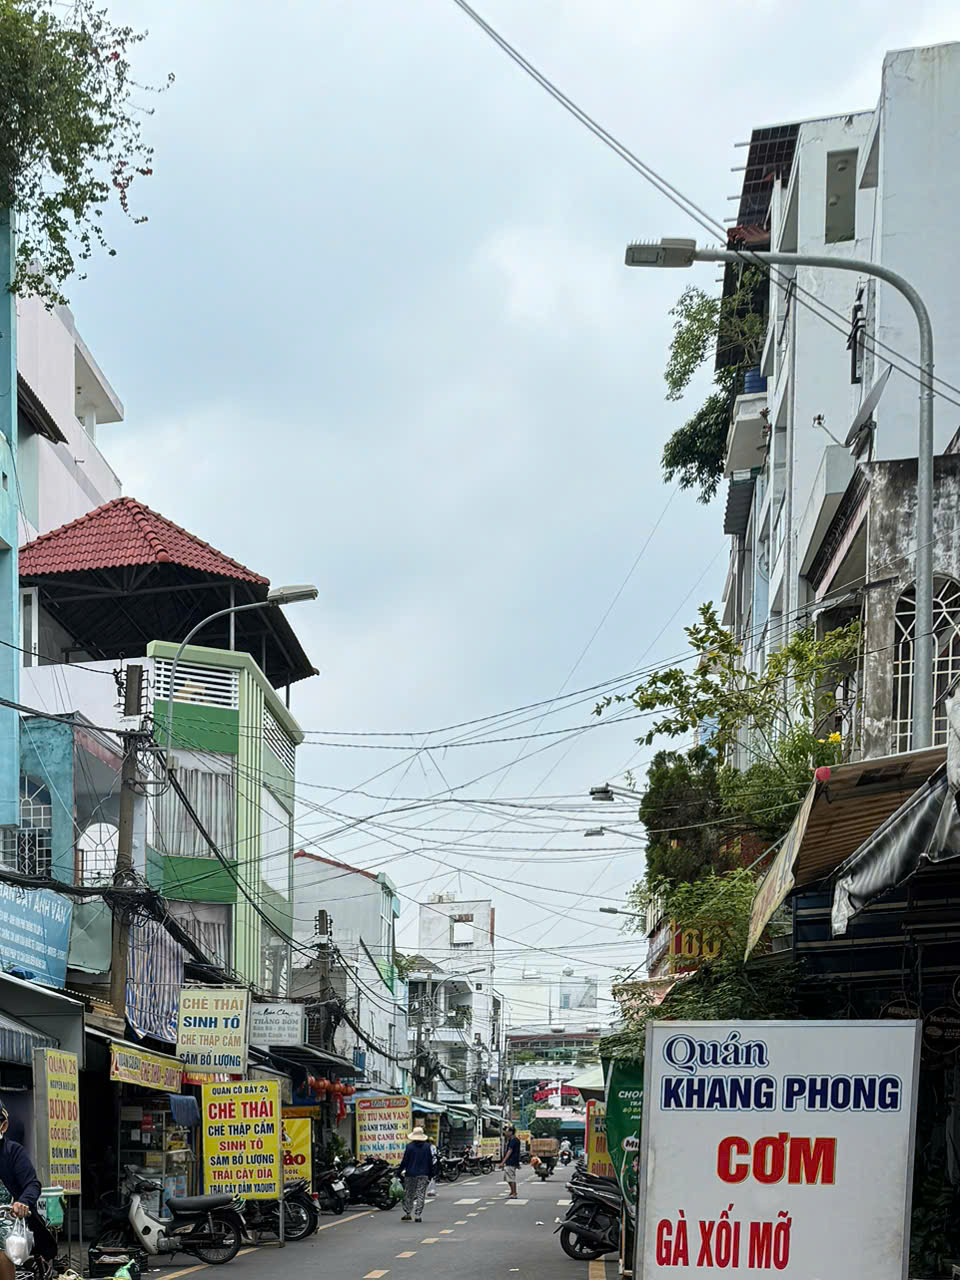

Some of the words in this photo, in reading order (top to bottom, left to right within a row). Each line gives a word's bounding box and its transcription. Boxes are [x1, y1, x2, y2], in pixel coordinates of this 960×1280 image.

[182, 996, 209, 1010] CHÈ
[214, 996, 243, 1011] THÁI
[183, 1016, 218, 1028] SINH
[222, 1013, 241, 1029] TỐ
[180, 1032, 196, 1046] CHÈ
[180, 1051, 198, 1066] SÂM
[214, 1053, 241, 1069] LƯỢNG
[664, 1031, 769, 1074] Quán
[48, 1054, 67, 1074] QUÁN
[212, 1086, 231, 1095] QUÁN
[232, 1085, 242, 1094] CÔ
[661, 1075, 776, 1112] KHANG
[782, 1075, 902, 1112] PHONG
[49, 1093, 66, 1120] BÚN
[67, 1096, 78, 1121] BÒ
[208, 1099, 236, 1120] CHÈ
[240, 1097, 273, 1118] THÁI
[208, 1122, 225, 1136] CHÈ
[51, 1145, 63, 1158] BÚN
[219, 1140, 246, 1152] SINH
[625, 1140, 640, 1149] MI
[210, 1154, 229, 1166] SÂM
[283, 1150, 306, 1166] ảo
[717, 1132, 837, 1185] CƠM
[212, 1168, 233, 1180] TRÁI
[236, 1167, 254, 1179] CÂY
[656, 1209, 690, 1268] GÀ
[696, 1203, 741, 1269] XỐI
[748, 1210, 792, 1271] MỠ
